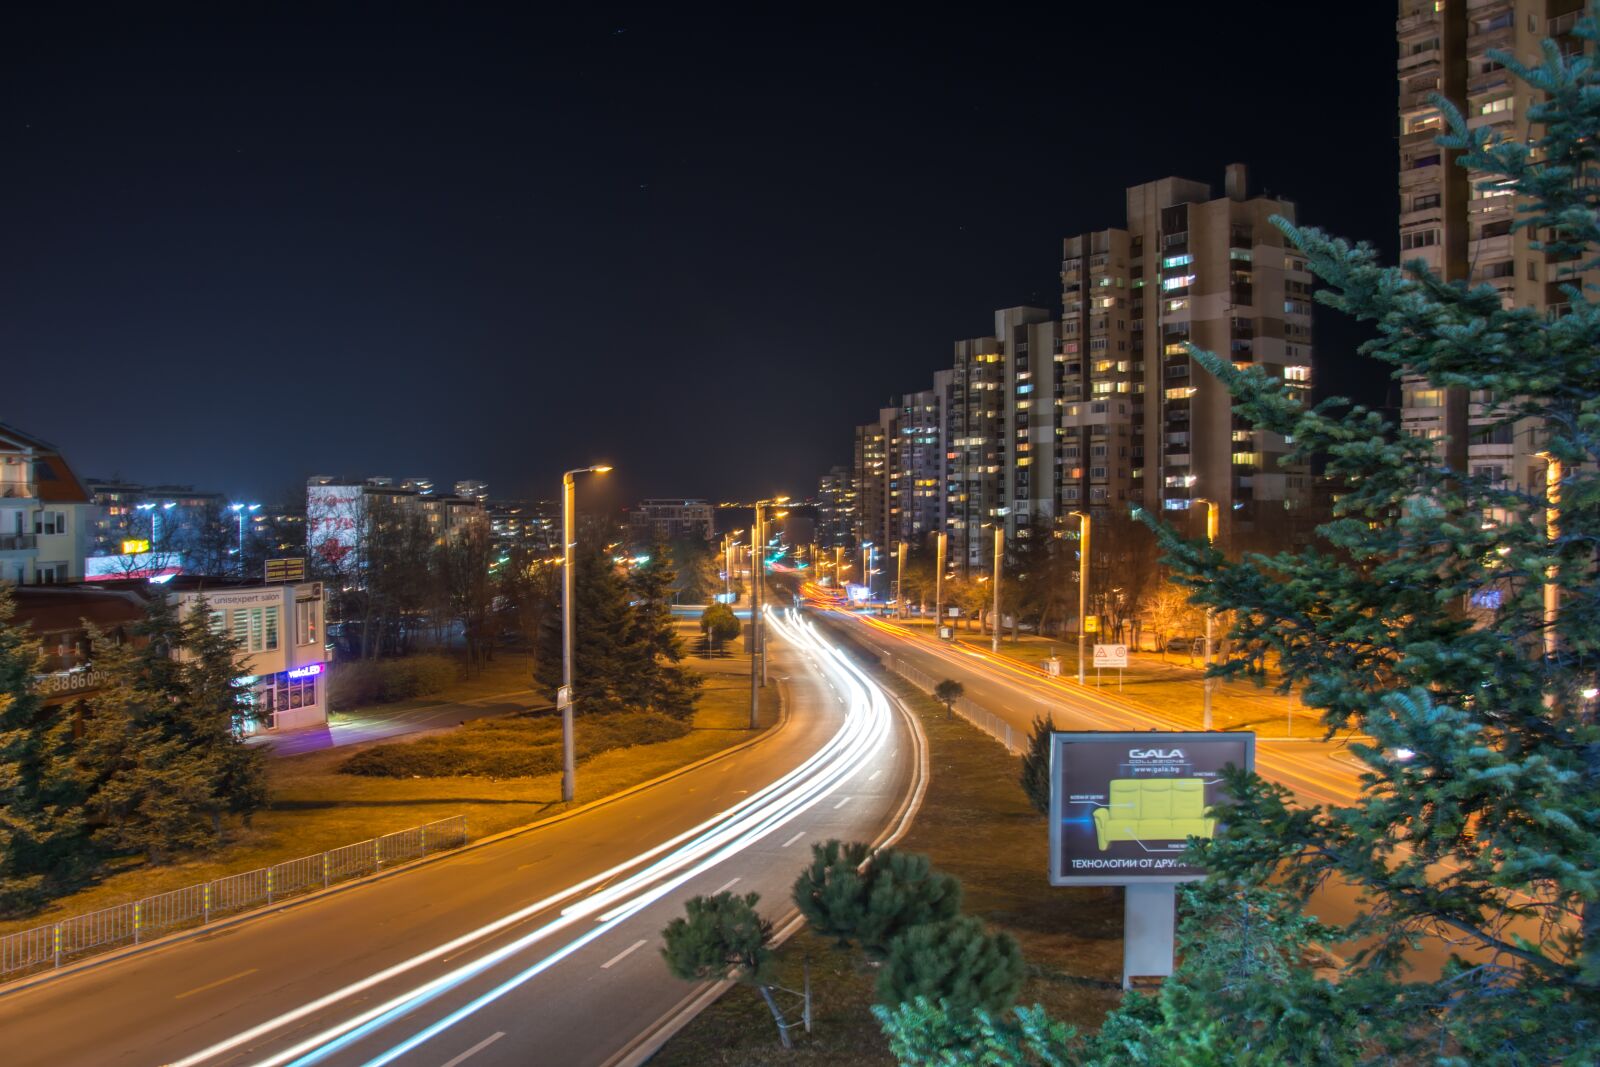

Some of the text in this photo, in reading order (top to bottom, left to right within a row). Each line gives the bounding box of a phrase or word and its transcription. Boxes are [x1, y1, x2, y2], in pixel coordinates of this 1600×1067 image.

[261, 593, 279, 601] salon
[1129, 749, 1184, 758] GALA
[1134, 766, 1180, 774] www.gala.bg
[1072, 859, 1137, 869] ТЕХНОЛОГИИ
[1139, 858, 1153, 868] ОТ
